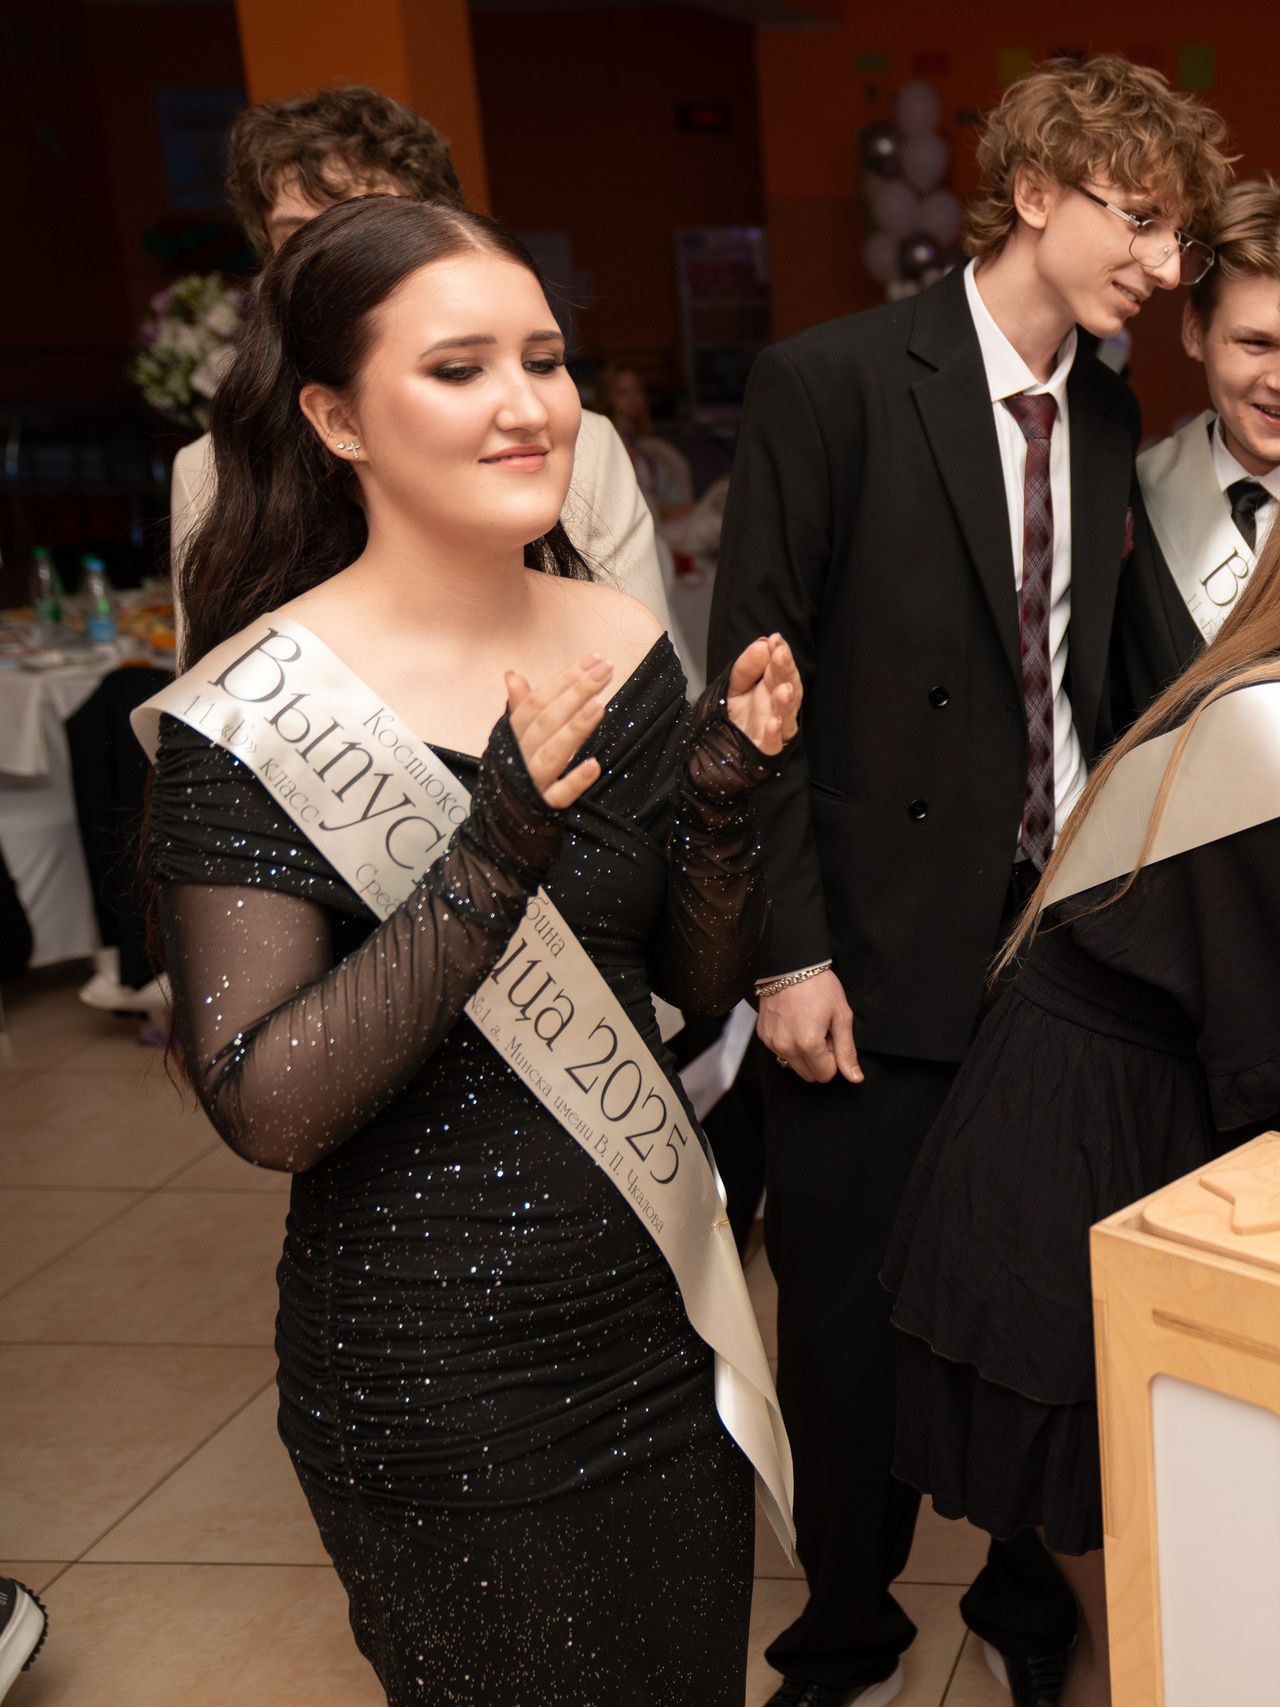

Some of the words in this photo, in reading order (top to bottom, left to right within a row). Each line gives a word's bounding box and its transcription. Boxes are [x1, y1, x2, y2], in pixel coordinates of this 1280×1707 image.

[363, 707, 469, 826] Костюко
[525, 896, 566, 958] бина
[260, 758, 320, 823] класс
[504, 1035, 553, 1097] Минска
[553, 1096, 594, 1141] имени
[627, 1168, 664, 1234] Чкалова
[564, 1016, 689, 1185] 2025
